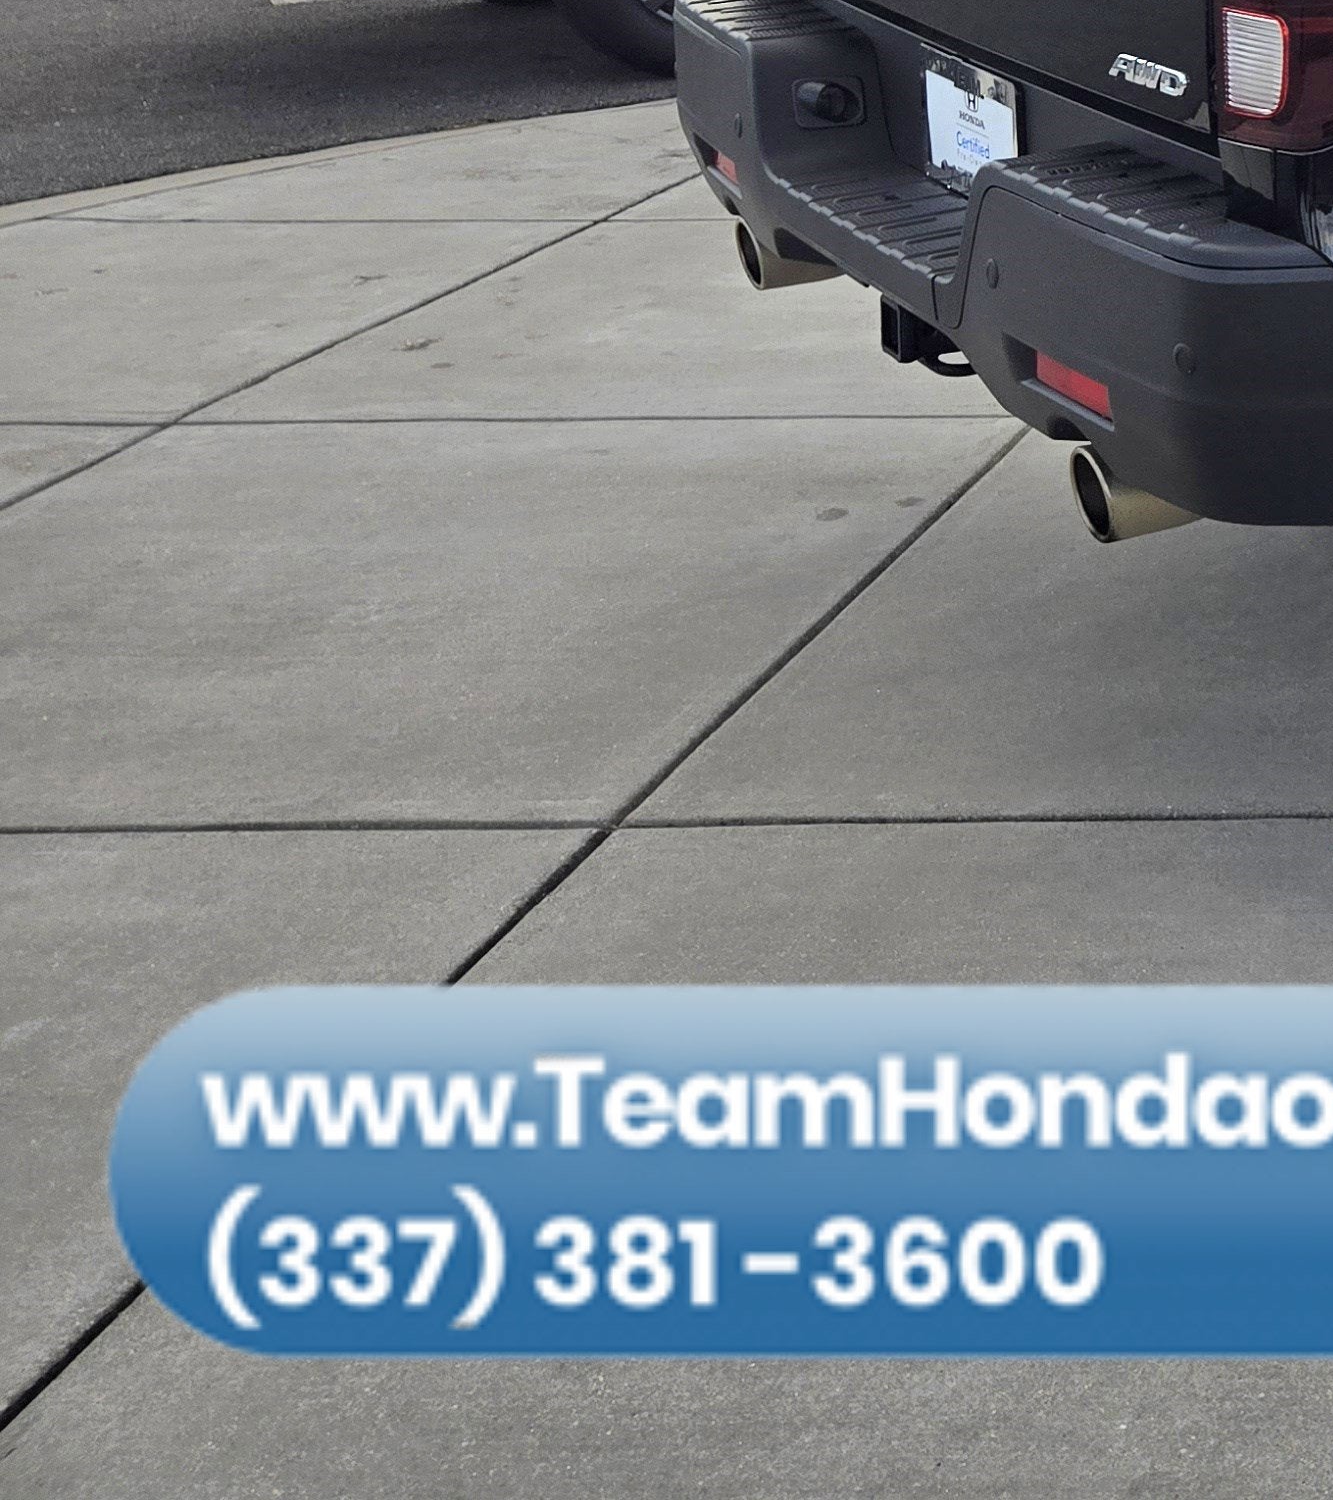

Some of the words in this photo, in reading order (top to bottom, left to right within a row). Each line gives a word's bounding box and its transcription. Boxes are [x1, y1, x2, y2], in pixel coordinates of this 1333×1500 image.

[1107, 52, 1189, 98] AWD
[958, 110, 987, 131] HONDA
[955, 130, 991, 160] Certified
